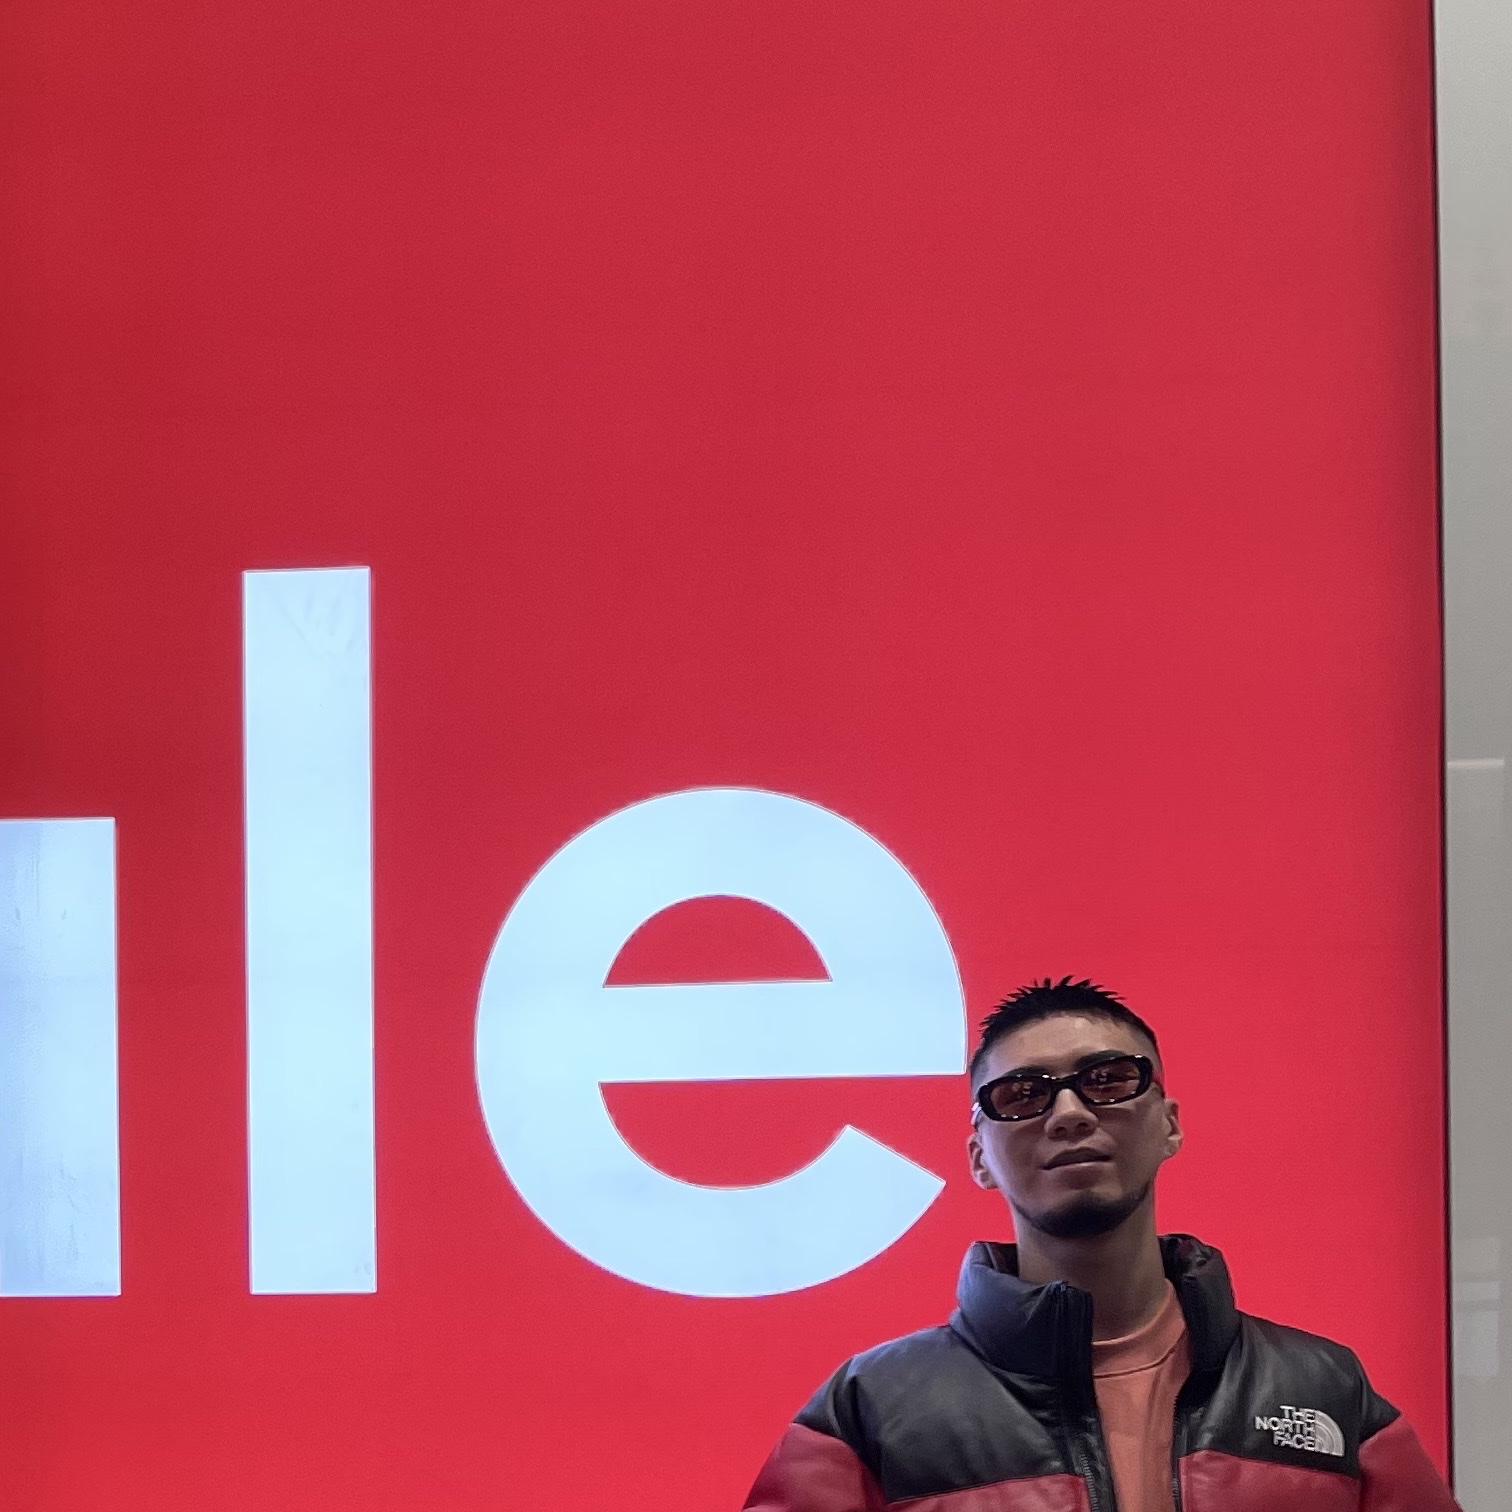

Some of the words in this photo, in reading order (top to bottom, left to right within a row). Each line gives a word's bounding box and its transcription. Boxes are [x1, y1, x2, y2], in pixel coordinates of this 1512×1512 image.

[1279, 1405, 1316, 1421] THE
[1254, 1416, 1316, 1435] NORTH
[1273, 1431, 1316, 1451] FACE
